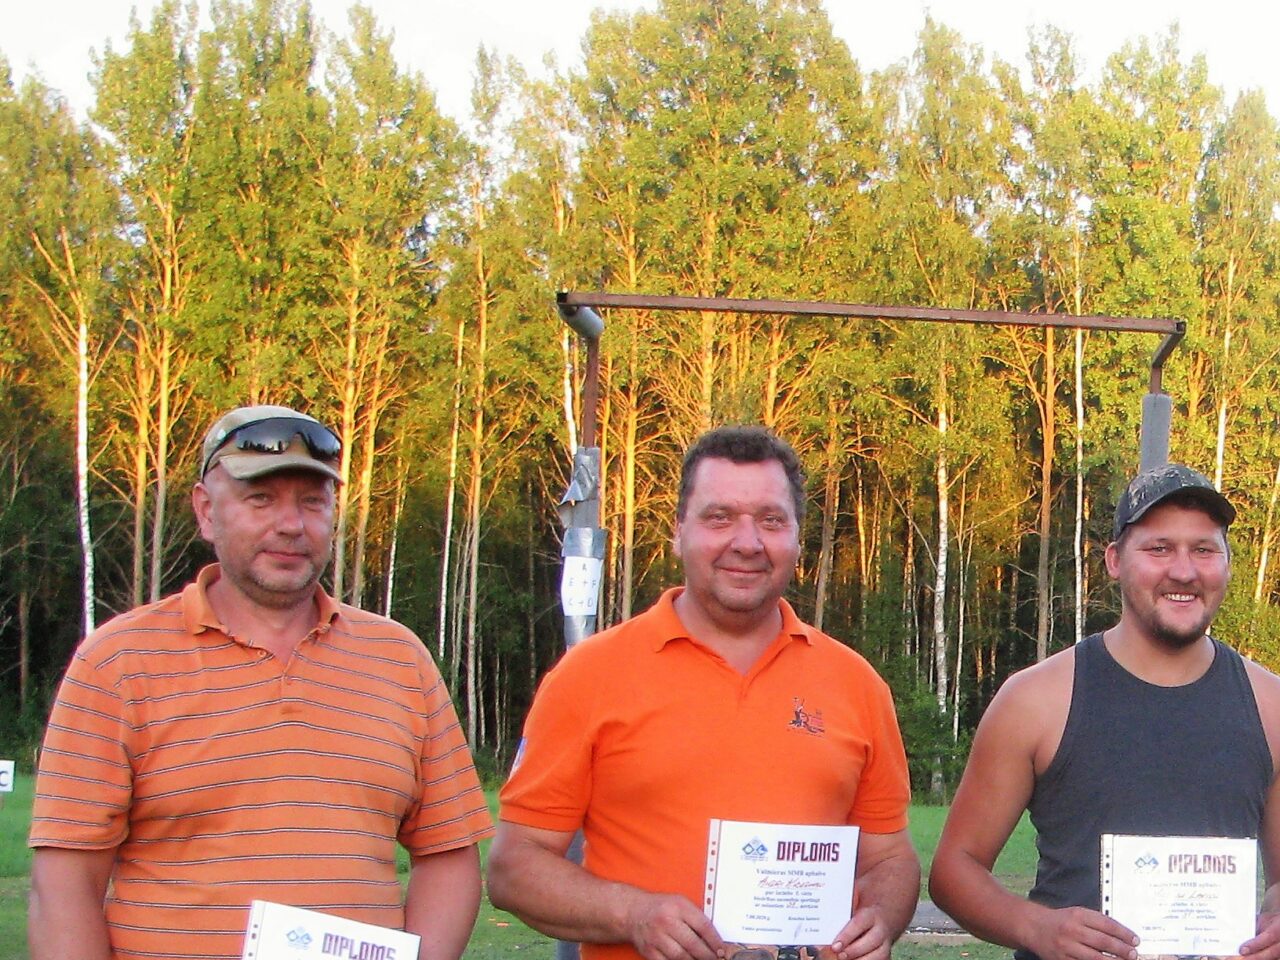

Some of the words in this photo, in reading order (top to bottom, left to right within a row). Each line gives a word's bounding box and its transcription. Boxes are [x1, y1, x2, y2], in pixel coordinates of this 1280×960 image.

[0, 770, 9, 787] C
[776, 840, 840, 862] DIPLOMS
[1168, 854, 1237, 874] DIPLOMS
